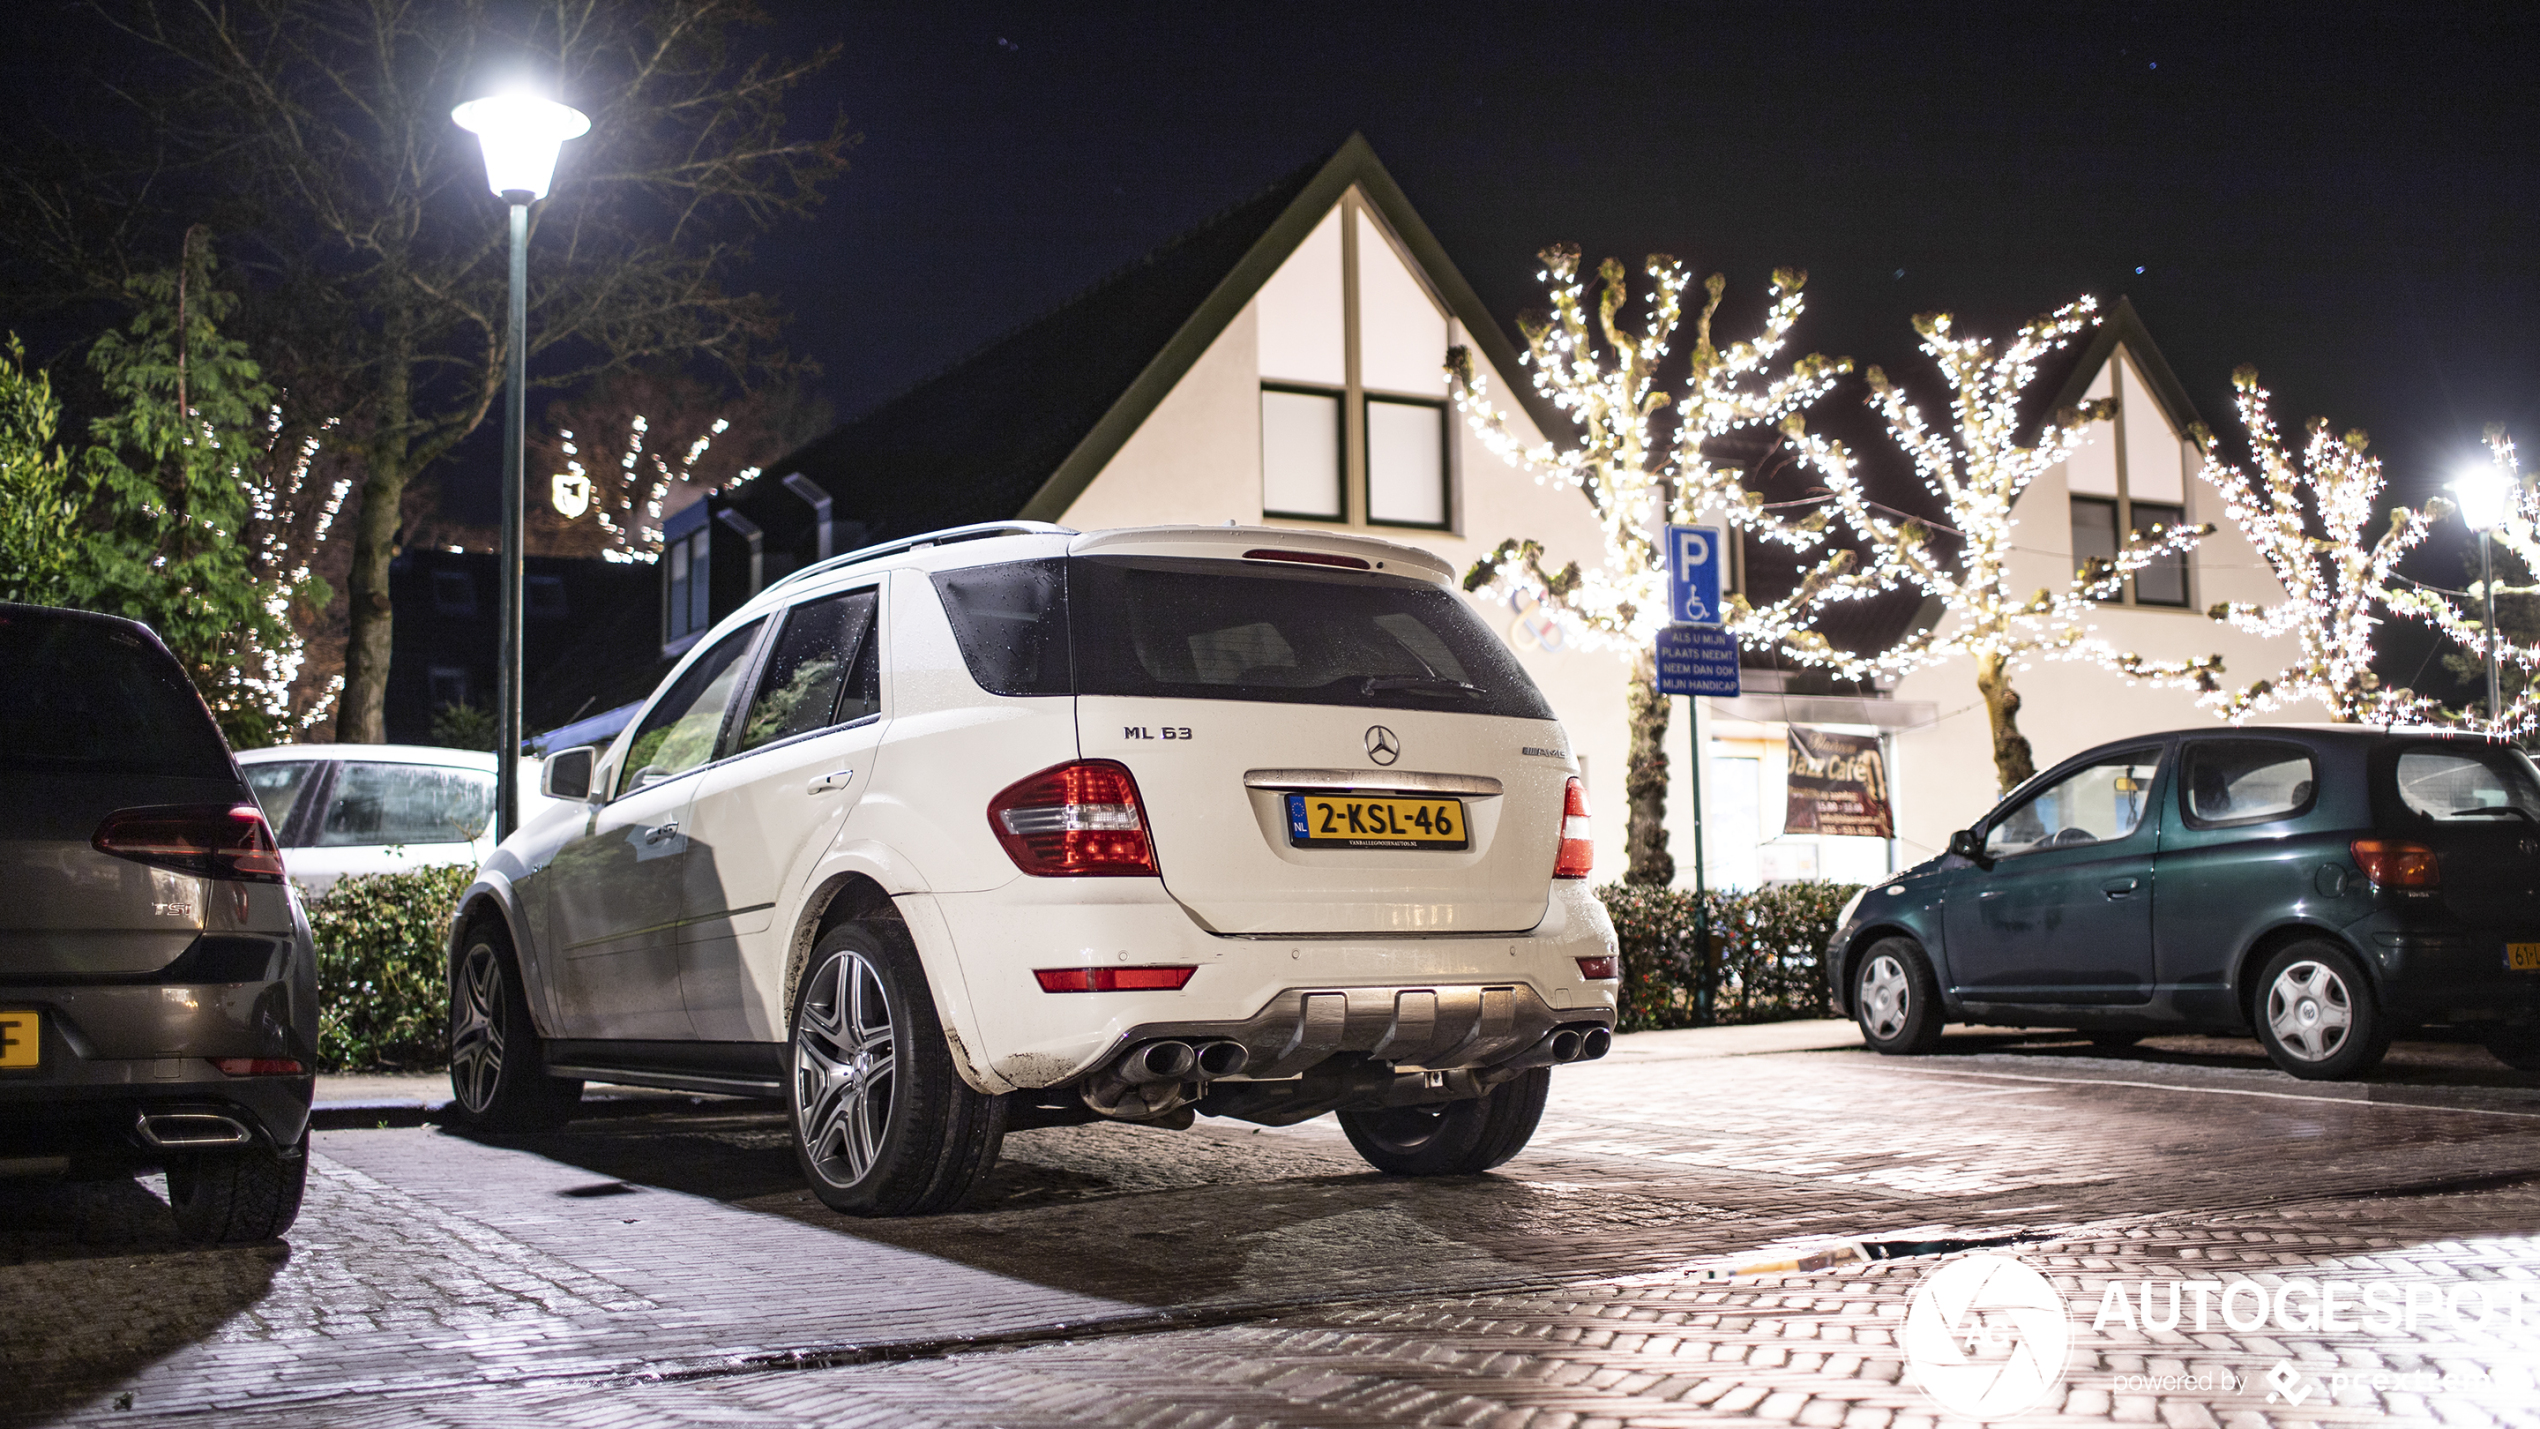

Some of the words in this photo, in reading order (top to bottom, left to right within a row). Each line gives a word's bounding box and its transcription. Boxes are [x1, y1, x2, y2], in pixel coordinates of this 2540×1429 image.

[1681, 533, 1709, 582] P
[1672, 632, 1691, 644] ALS
[1693, 633, 1701, 644] U
[1703, 634, 1726, 645] MIJN
[1662, 647, 1700, 659] PLAATS
[1663, 663, 1691, 674] NEEM
[1693, 664, 1713, 675] DAN
[1716, 665, 1736, 676] OOK
[1662, 678, 1687, 689] MIJN
[1689, 680, 1737, 691] HANDICAP
[1123, 726, 1155, 740] ML
[1160, 727, 1193, 740] 63
[1788, 749, 1826, 778] Jazz
[1828, 754, 1867, 782] Café
[1316, 803, 1453, 835] 2-KSL-46
[1294, 822, 1307, 832] NL
